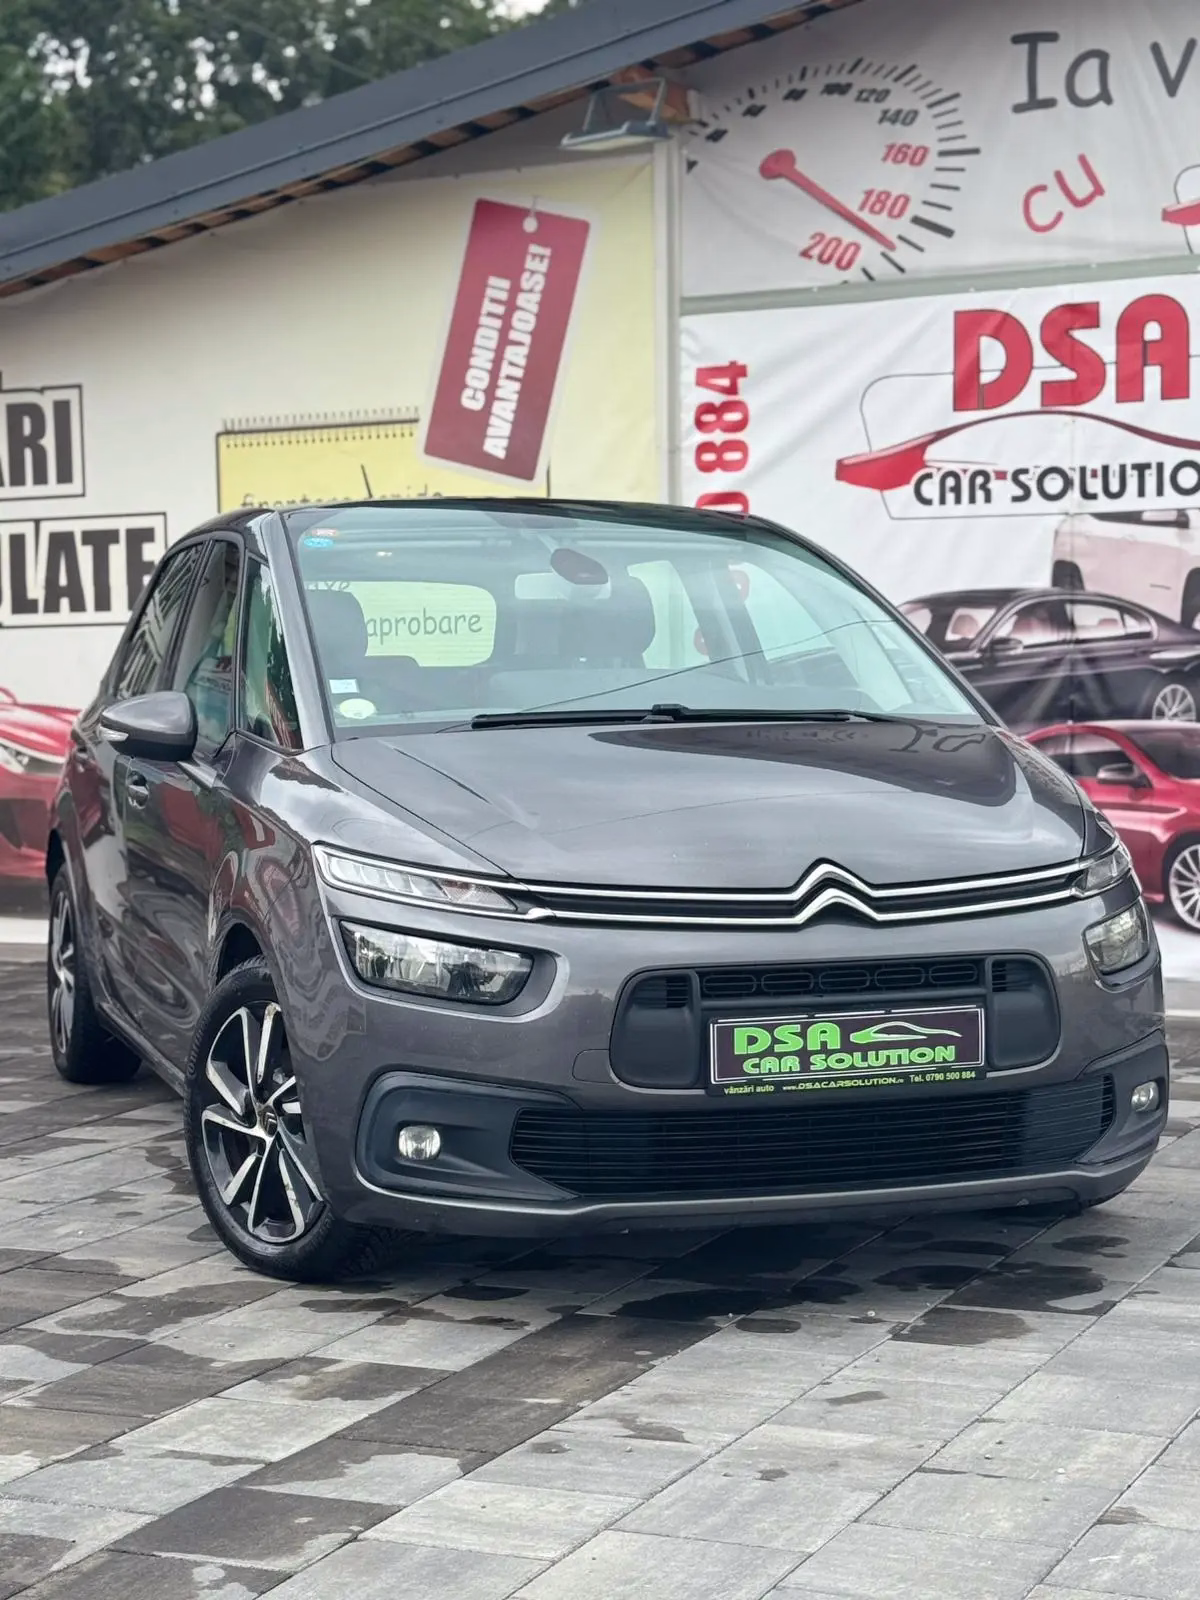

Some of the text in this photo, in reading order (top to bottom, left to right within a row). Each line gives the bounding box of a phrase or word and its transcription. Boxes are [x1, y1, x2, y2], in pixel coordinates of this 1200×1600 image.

[1011, 30, 1114, 114] Ia
[877, 108, 919, 127] 140
[881, 143, 930, 168] 160
[857, 189, 911, 219] 180
[800, 231, 861, 271] 200
[460, 275, 511, 411] CONDITII
[953, 294, 1190, 411] DSA
[695, 360, 749, 472] 884
[0, 400, 73, 487] RI
[913, 471, 991, 506] CAR
[0, 527, 155, 614] LATE
[366, 607, 483, 645] aprobare
[733, 1022, 841, 1055] DSA
[743, 1045, 955, 1074] CAR SOLUTION
[755, 1084, 775, 1093] auto
[925, 1073, 945, 1082] 0790
[946, 1072, 960, 1081] 500
[961, 1071, 976, 1079] 884
